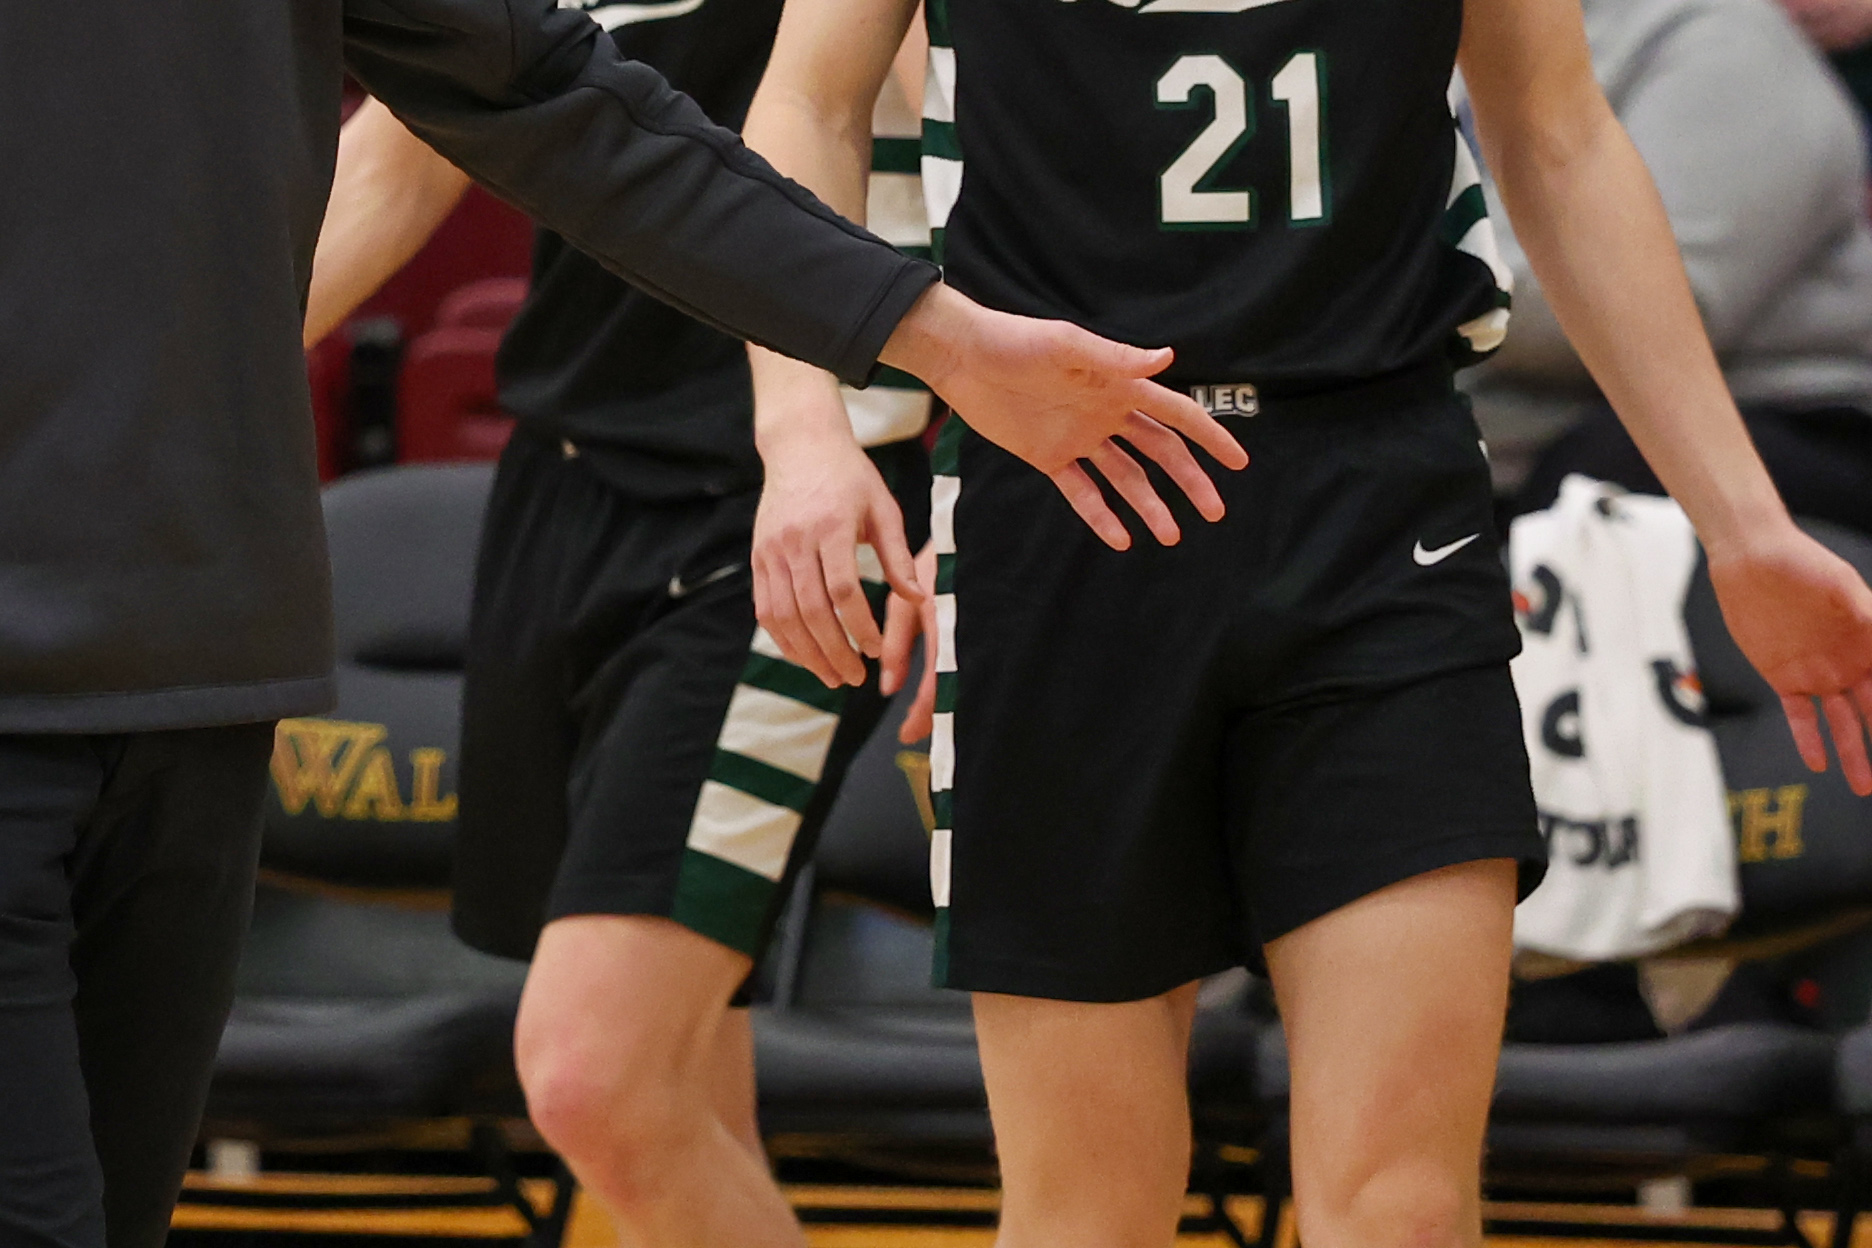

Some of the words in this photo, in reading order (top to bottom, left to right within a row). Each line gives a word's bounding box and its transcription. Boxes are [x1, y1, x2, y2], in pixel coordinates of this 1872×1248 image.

[1154, 51, 1326, 227] 21
[1191, 384, 1258, 416] LEC
[269, 718, 459, 822] WAL
